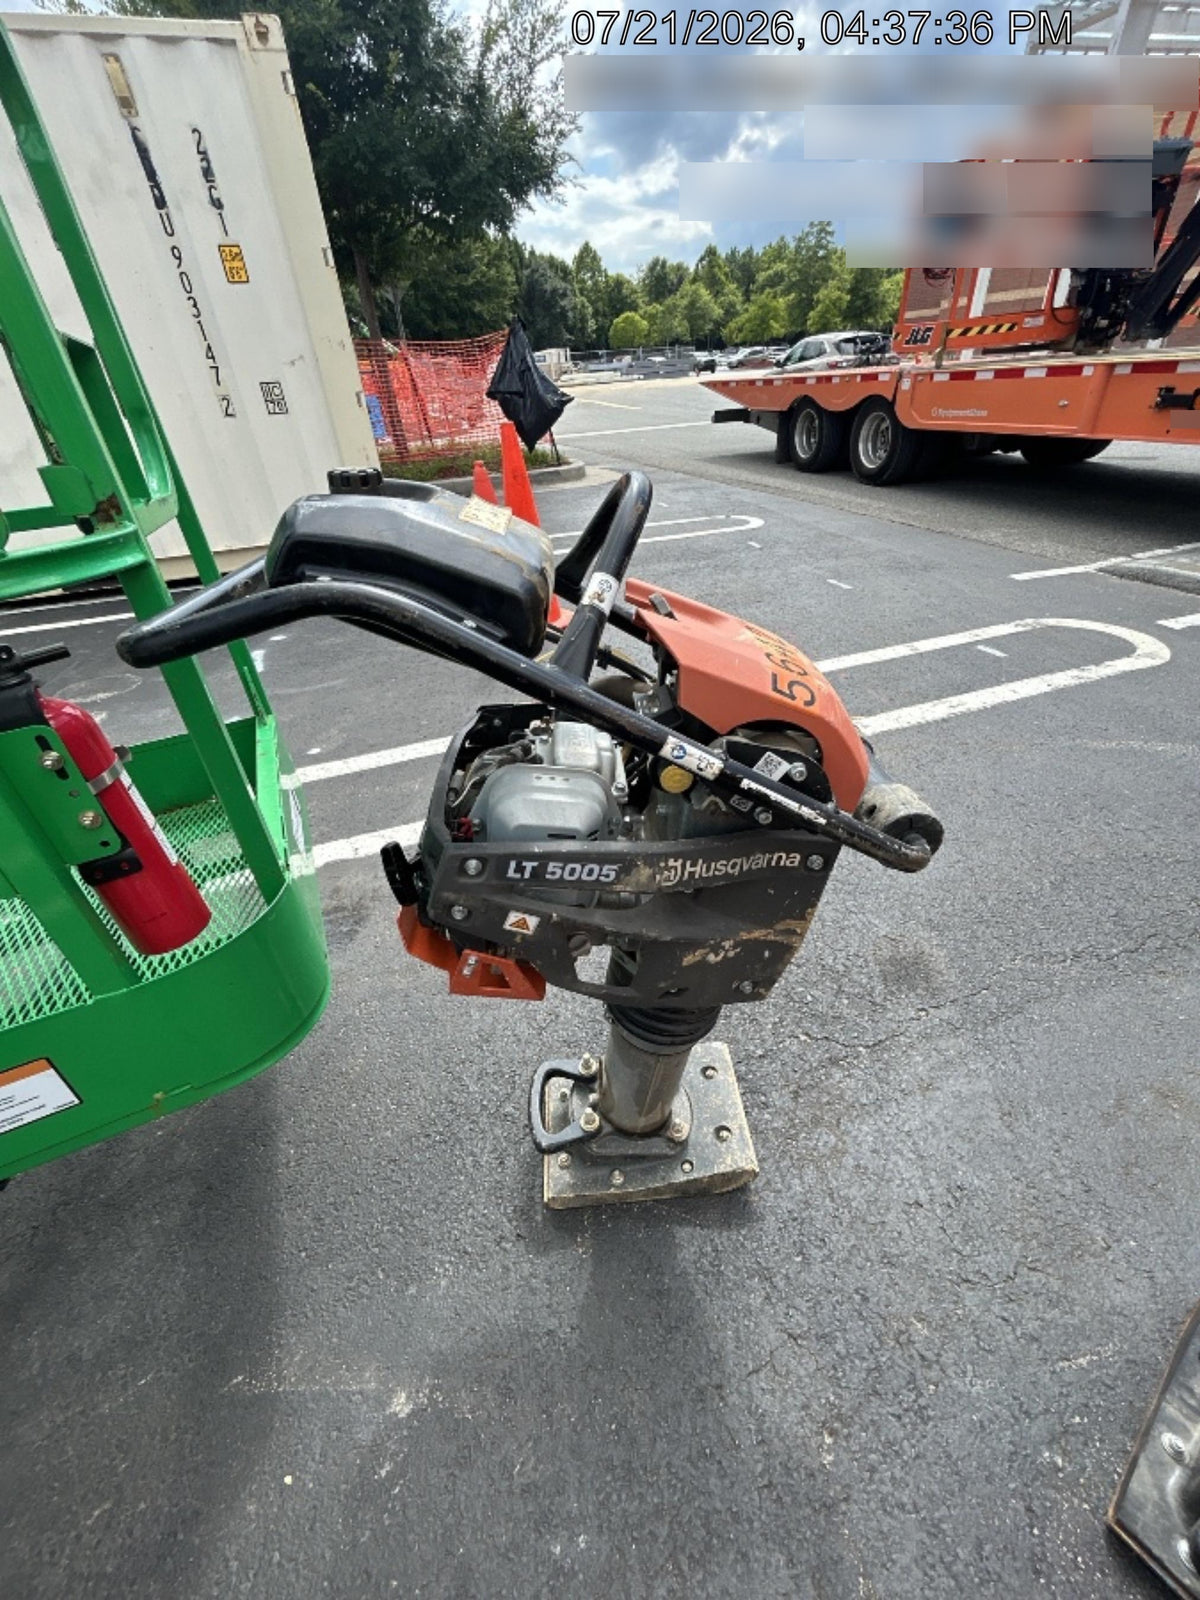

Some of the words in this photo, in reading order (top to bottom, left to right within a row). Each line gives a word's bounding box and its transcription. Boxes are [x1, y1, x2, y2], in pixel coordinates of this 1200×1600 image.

[506, 860, 535, 879] LT
[544, 860, 618, 882] 5005
[682, 851, 801, 879] Husqvarna
